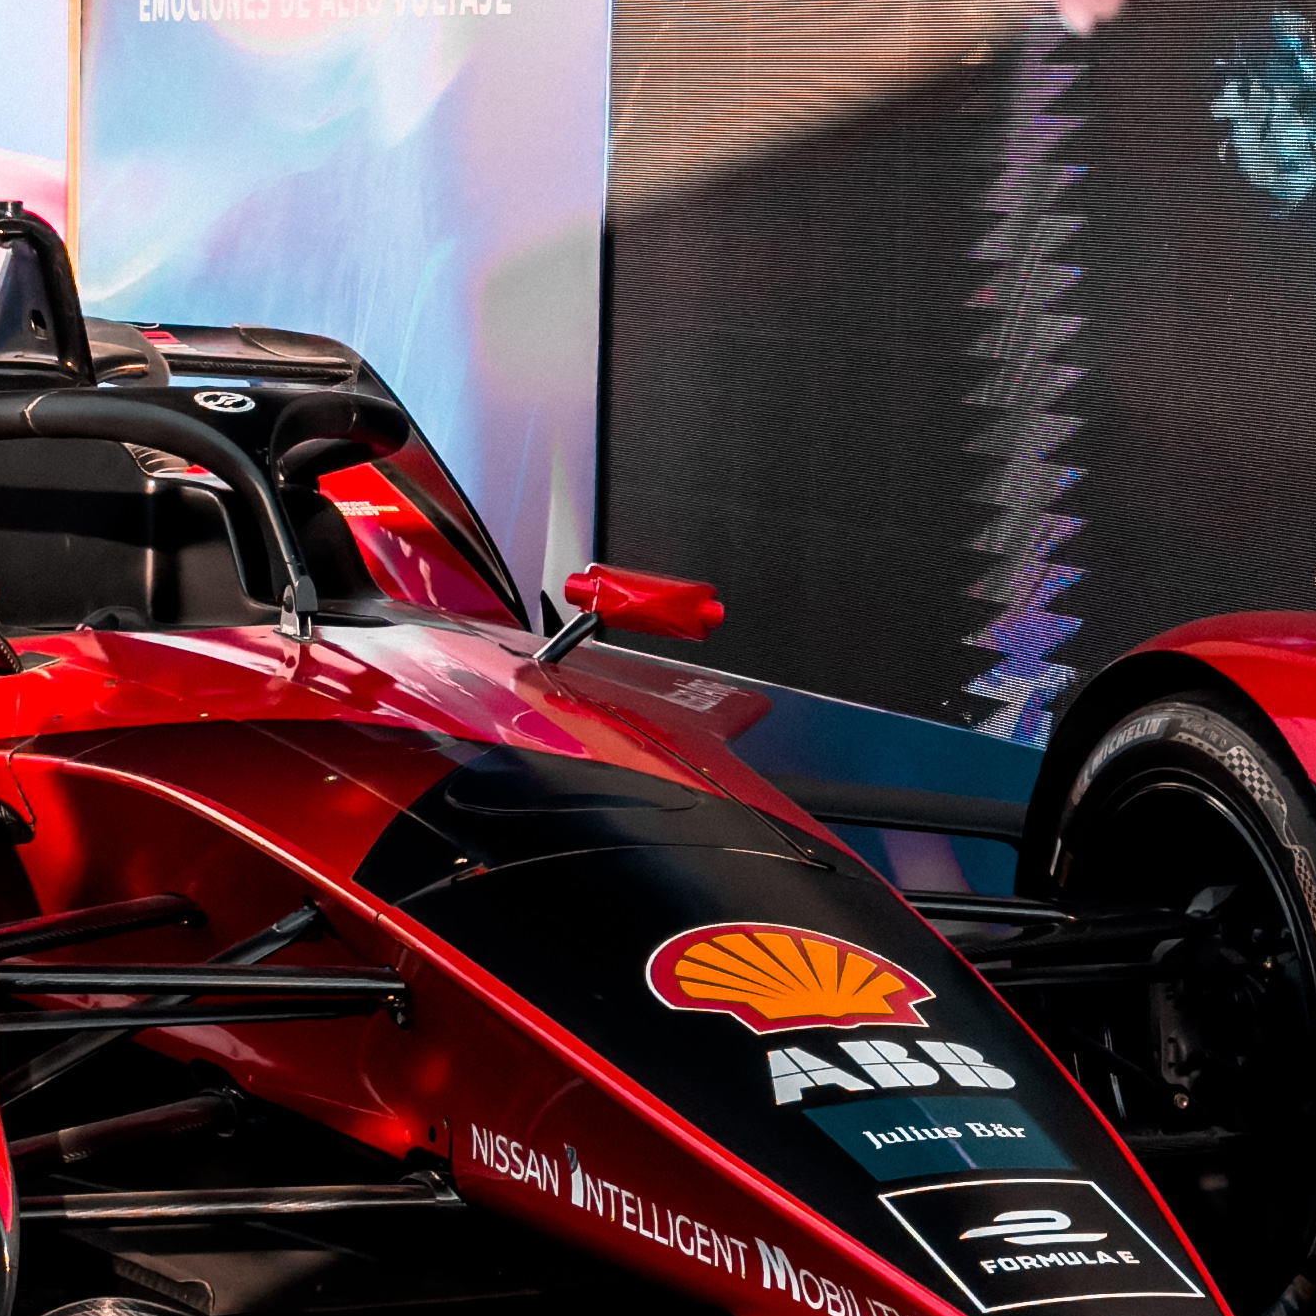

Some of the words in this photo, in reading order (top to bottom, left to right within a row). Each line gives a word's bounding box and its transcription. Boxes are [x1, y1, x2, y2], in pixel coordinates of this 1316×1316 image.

[767, 1039, 1016, 1106] ABB
[863, 1121, 963, 1150] Julius
[966, 1118, 1027, 1142] Bär
[471, 1123, 560, 1198] NISSAN
[980, 1251, 1117, 1275] FORMULA
[1118, 1249, 1139, 1266] E
